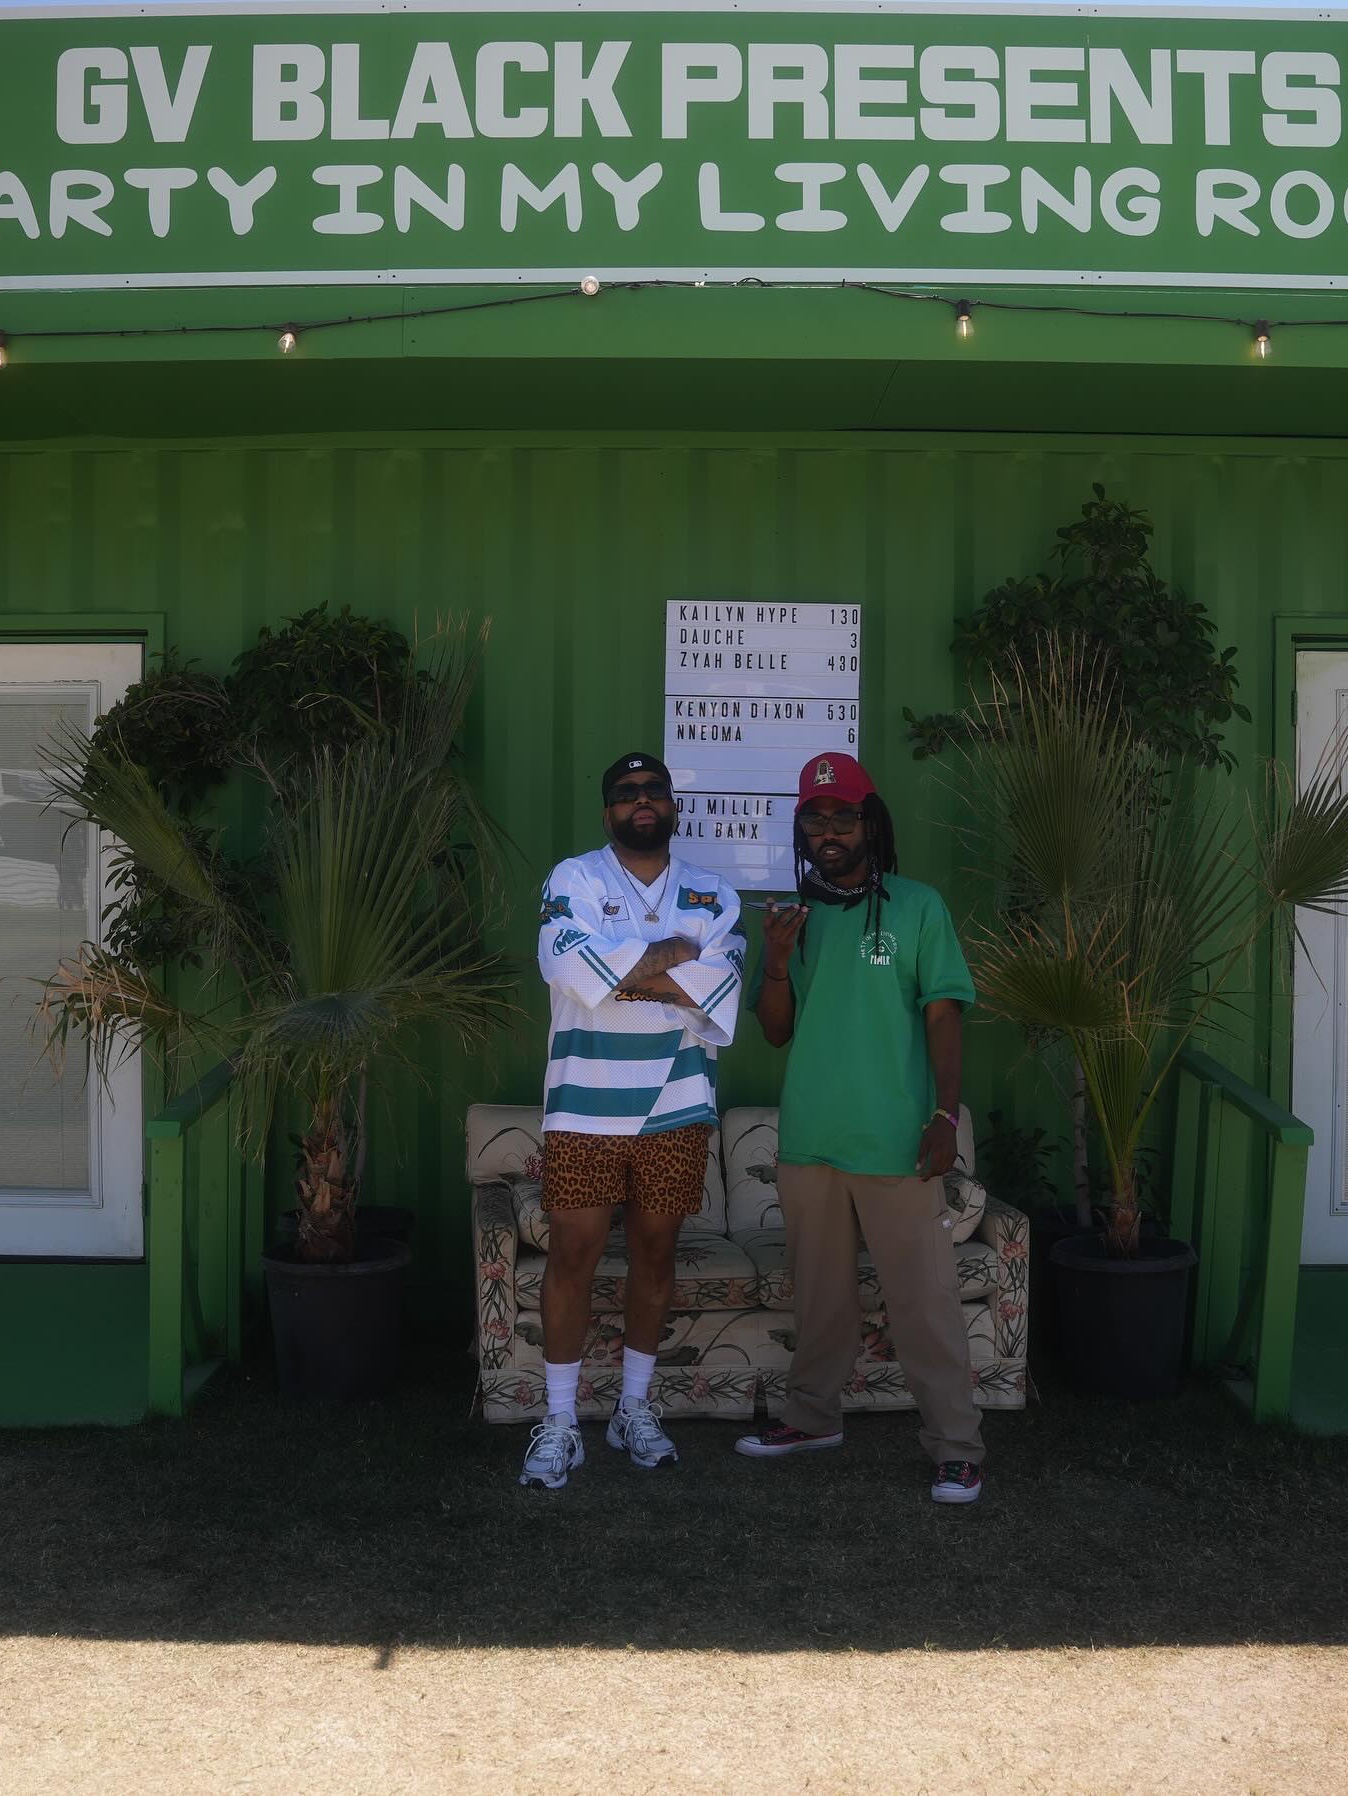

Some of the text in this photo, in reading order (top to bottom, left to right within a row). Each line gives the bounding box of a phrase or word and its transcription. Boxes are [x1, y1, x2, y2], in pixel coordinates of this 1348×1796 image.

[56, 41, 1342, 148] GV BLACK PRESENTS
[0, 162, 1348, 240] ARTY IN MY LIVING RO
[679, 605, 859, 625] KAILYN HYPE 130
[680, 628, 858, 649] DAUCHE 3
[680, 651, 859, 672] ZYAH BELLE 430
[675, 700, 858, 721] KENYON DIXON 530
[676, 723, 856, 744] NNEOMA 6
[676, 797, 773, 816] DJ MILLIE
[714, 822, 759, 840] BANX
